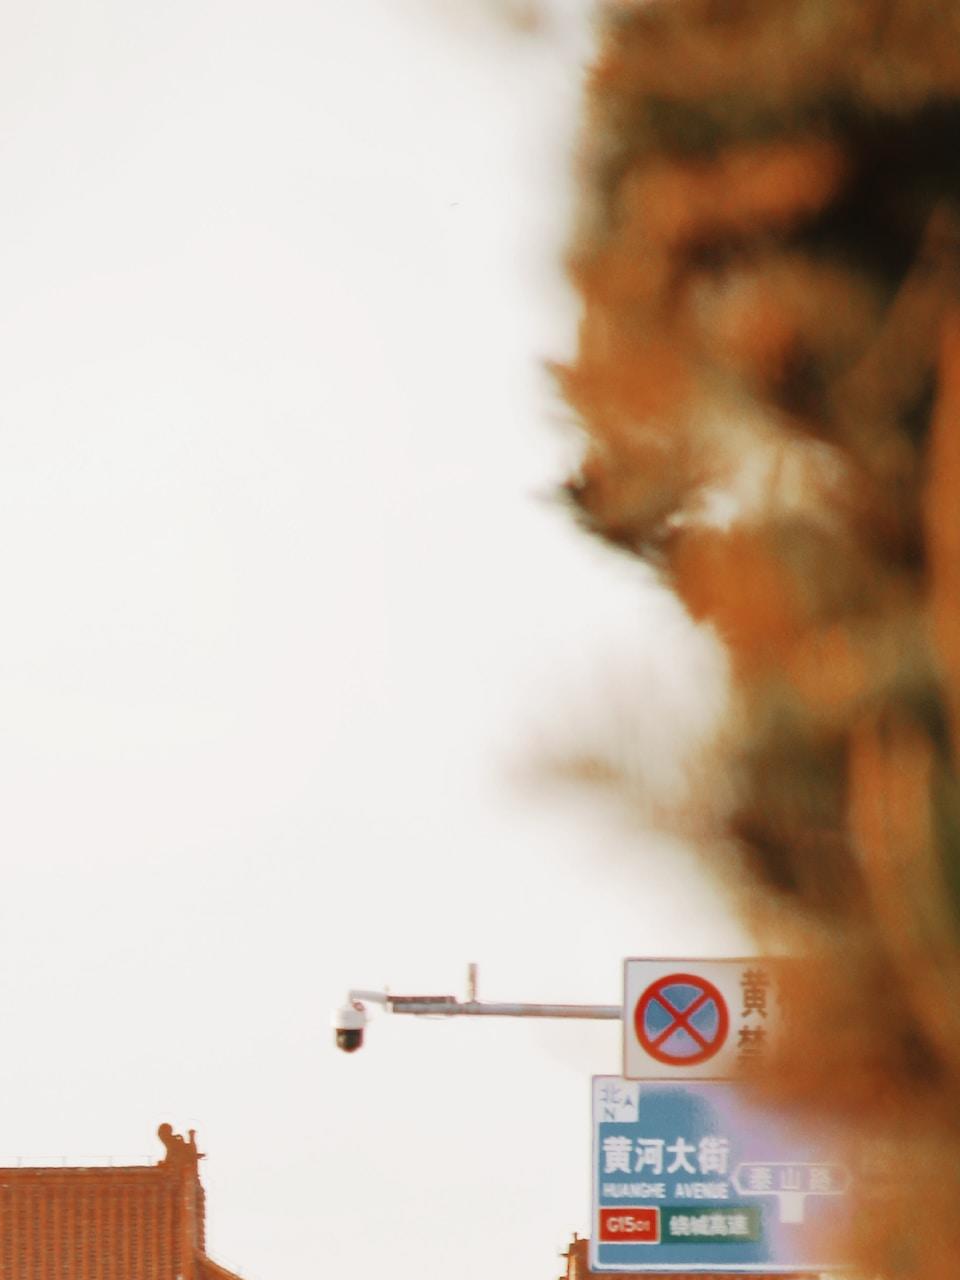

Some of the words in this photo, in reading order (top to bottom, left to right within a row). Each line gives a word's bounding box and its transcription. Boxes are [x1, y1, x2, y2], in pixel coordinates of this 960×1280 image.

[602, 1136, 729, 1175] 黄河大街
[603, 1182, 666, 1198] HUANGHE
[675, 1182, 729, 1199] AVENUE
